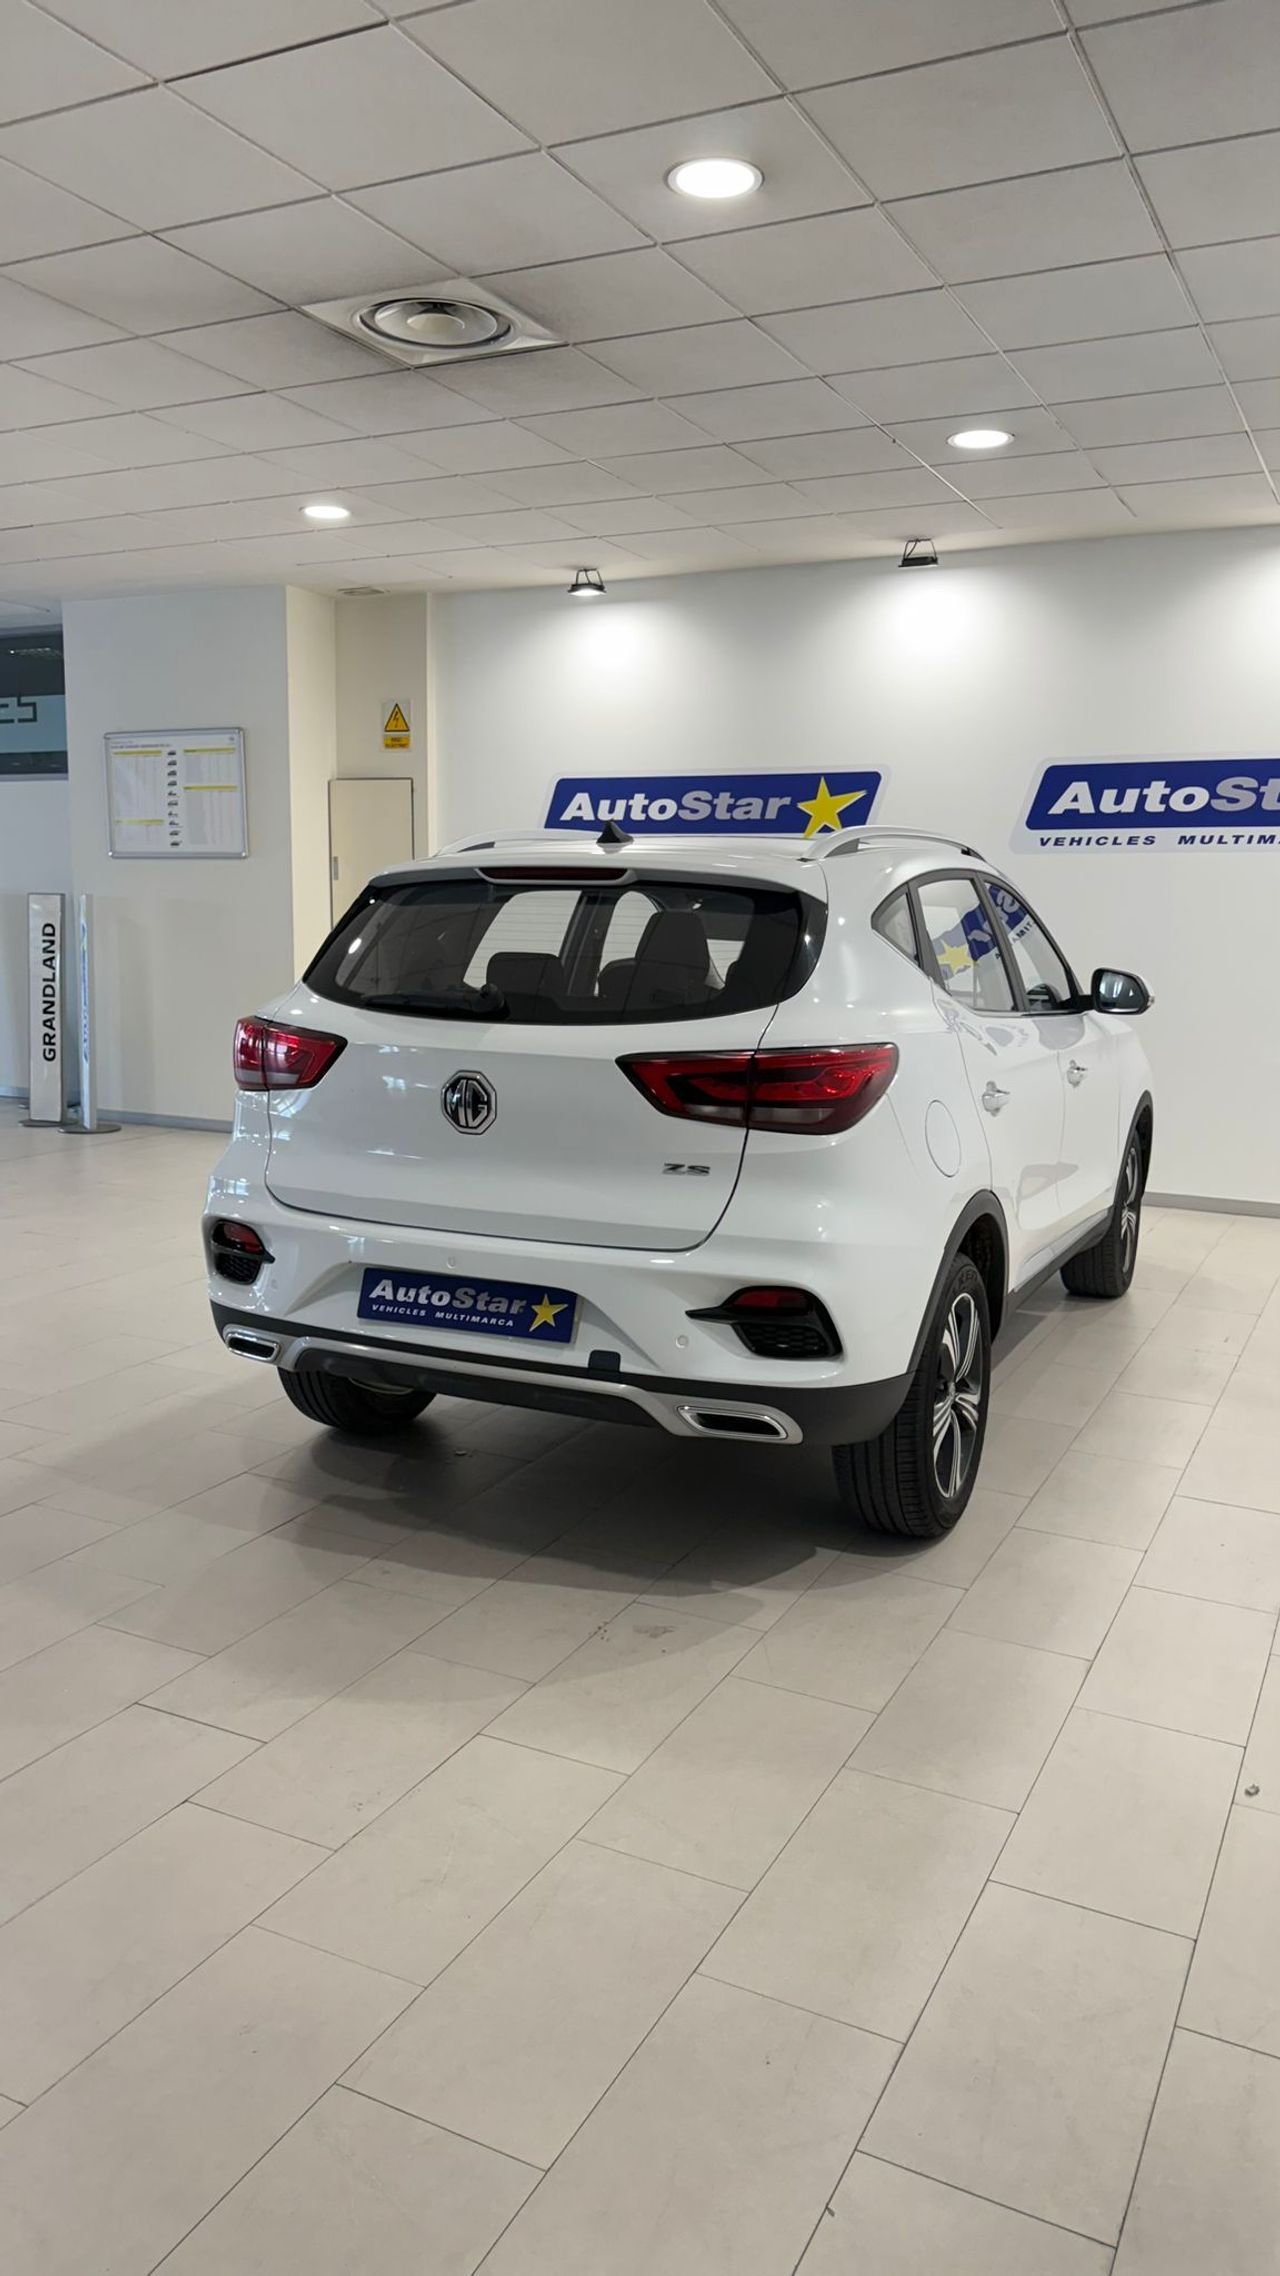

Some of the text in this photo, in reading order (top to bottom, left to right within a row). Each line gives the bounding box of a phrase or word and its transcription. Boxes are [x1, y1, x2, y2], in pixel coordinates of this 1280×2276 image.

[560, 790, 791, 821] AutoStar
[1039, 834, 1280, 846] VEHICLES MULTIM
[42, 922, 56, 1062] GRANDLAND
[444, 1077, 489, 1129] MG
[662, 1163, 711, 1176] ZS
[369, 1279, 527, 1315] AutoStar
[372, 1304, 514, 1327] VEHICLES MULTIMARCA
